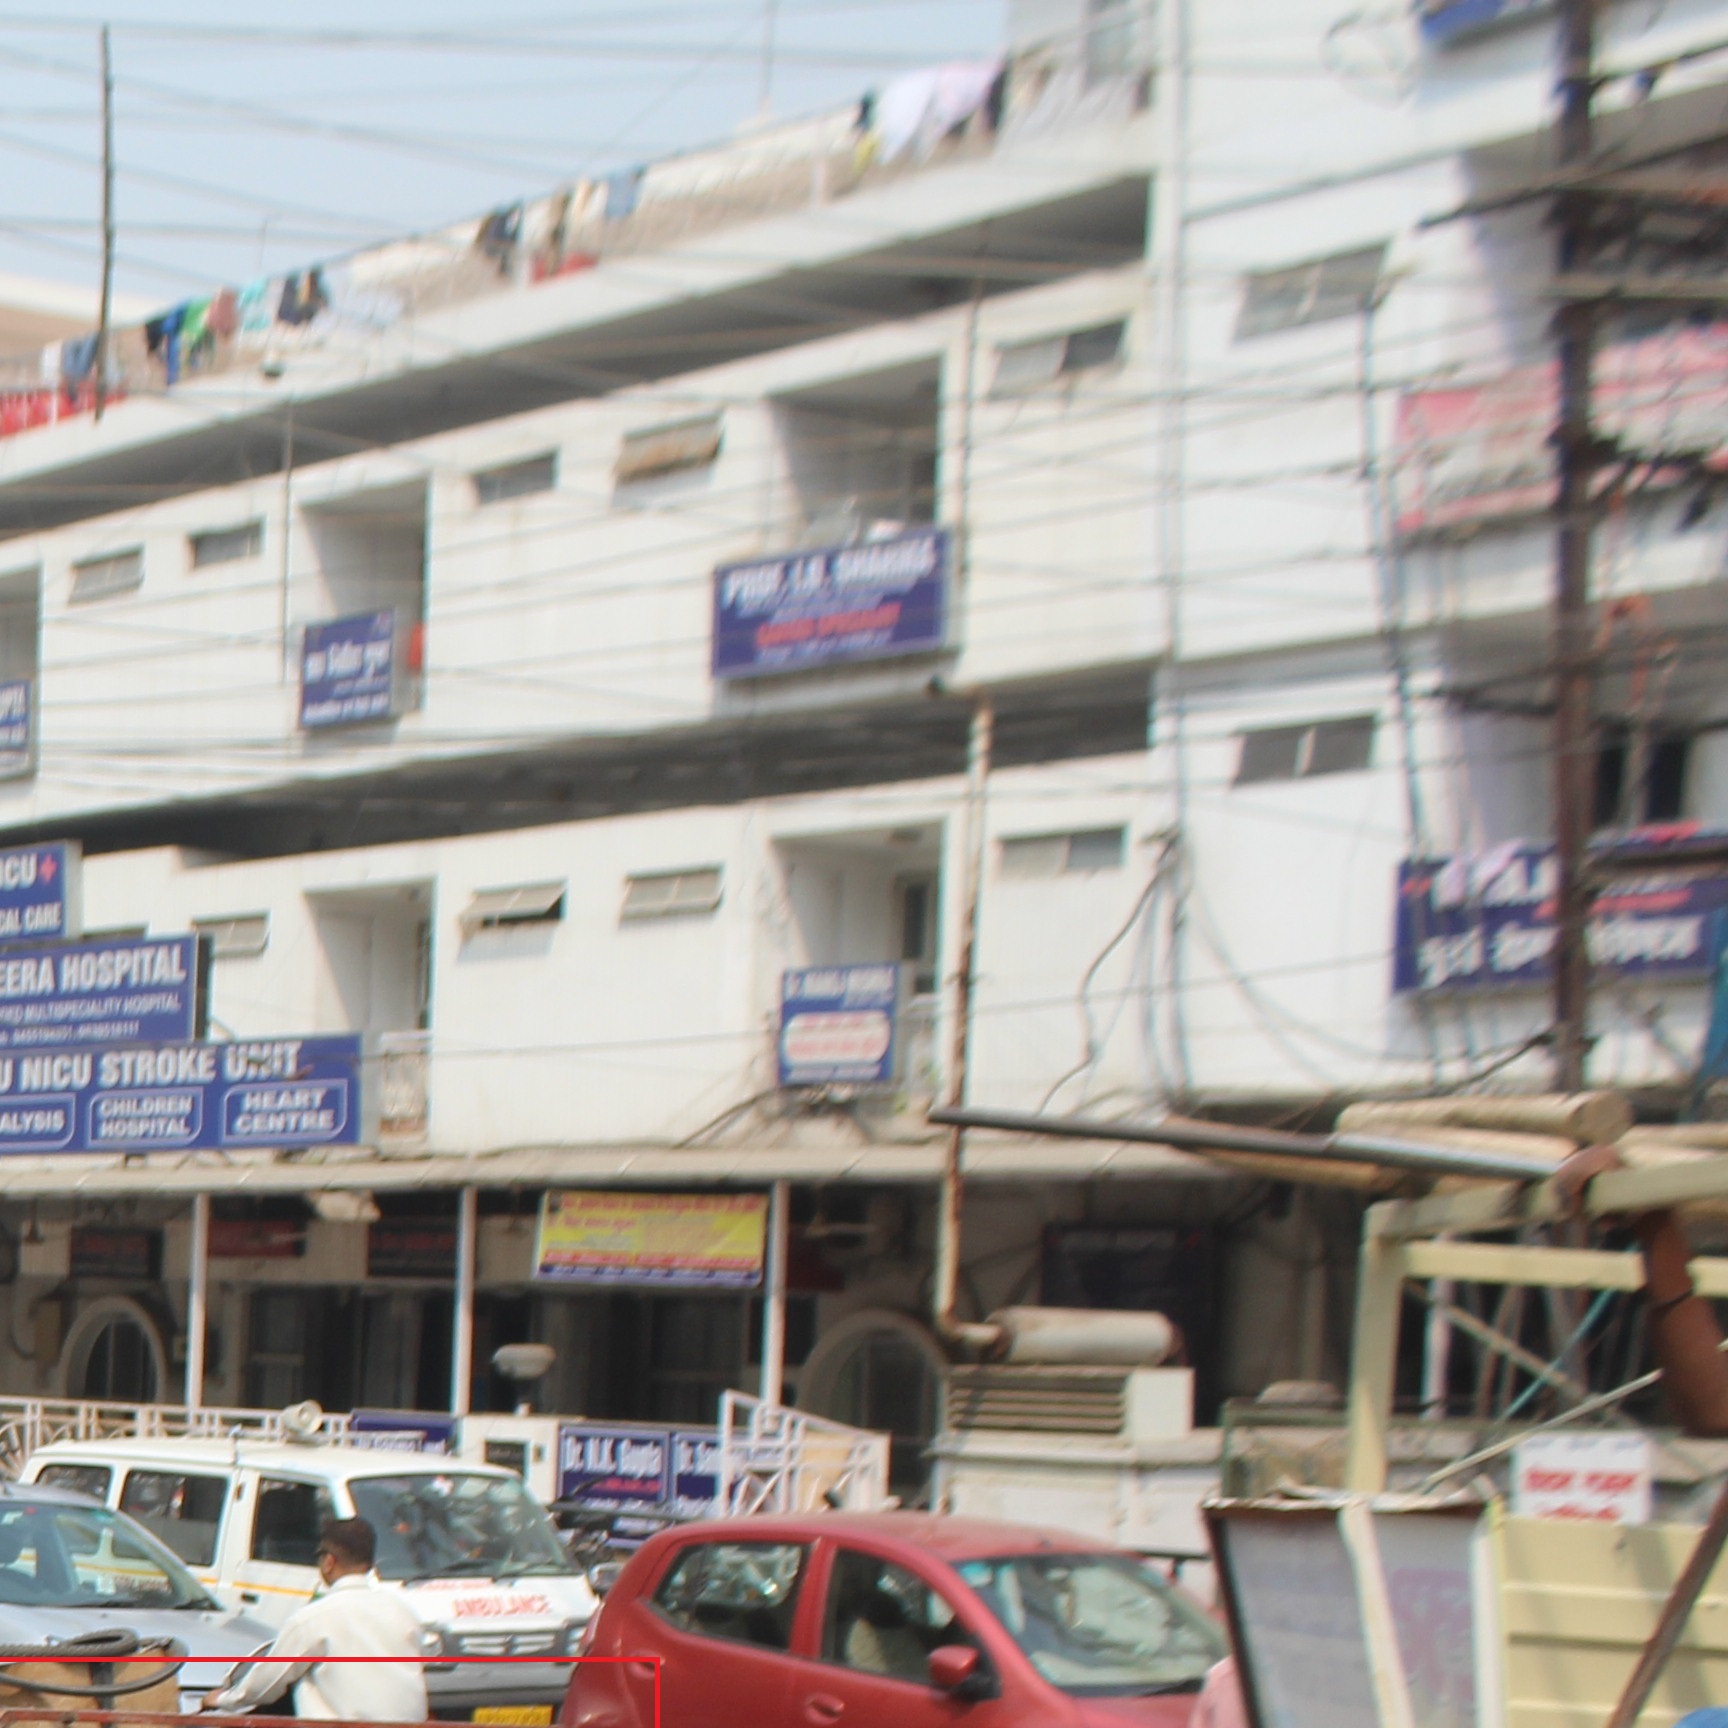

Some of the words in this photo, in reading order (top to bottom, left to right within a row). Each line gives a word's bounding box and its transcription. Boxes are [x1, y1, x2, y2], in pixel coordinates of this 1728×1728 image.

[24, 901, 63, 930] CARE
[60, 944, 186, 993] HOSPITAL
[19, 1053, 92, 1092] NICU
[100, 1046, 217, 1088] STROKE
[224, 1041, 302, 1080] UNIT
[99, 1095, 193, 1119] CHILDREN
[245, 1088, 327, 1112] HEART
[100, 1115, 190, 1139] HOSPITAL
[235, 1109, 335, 1134] CENTRE
